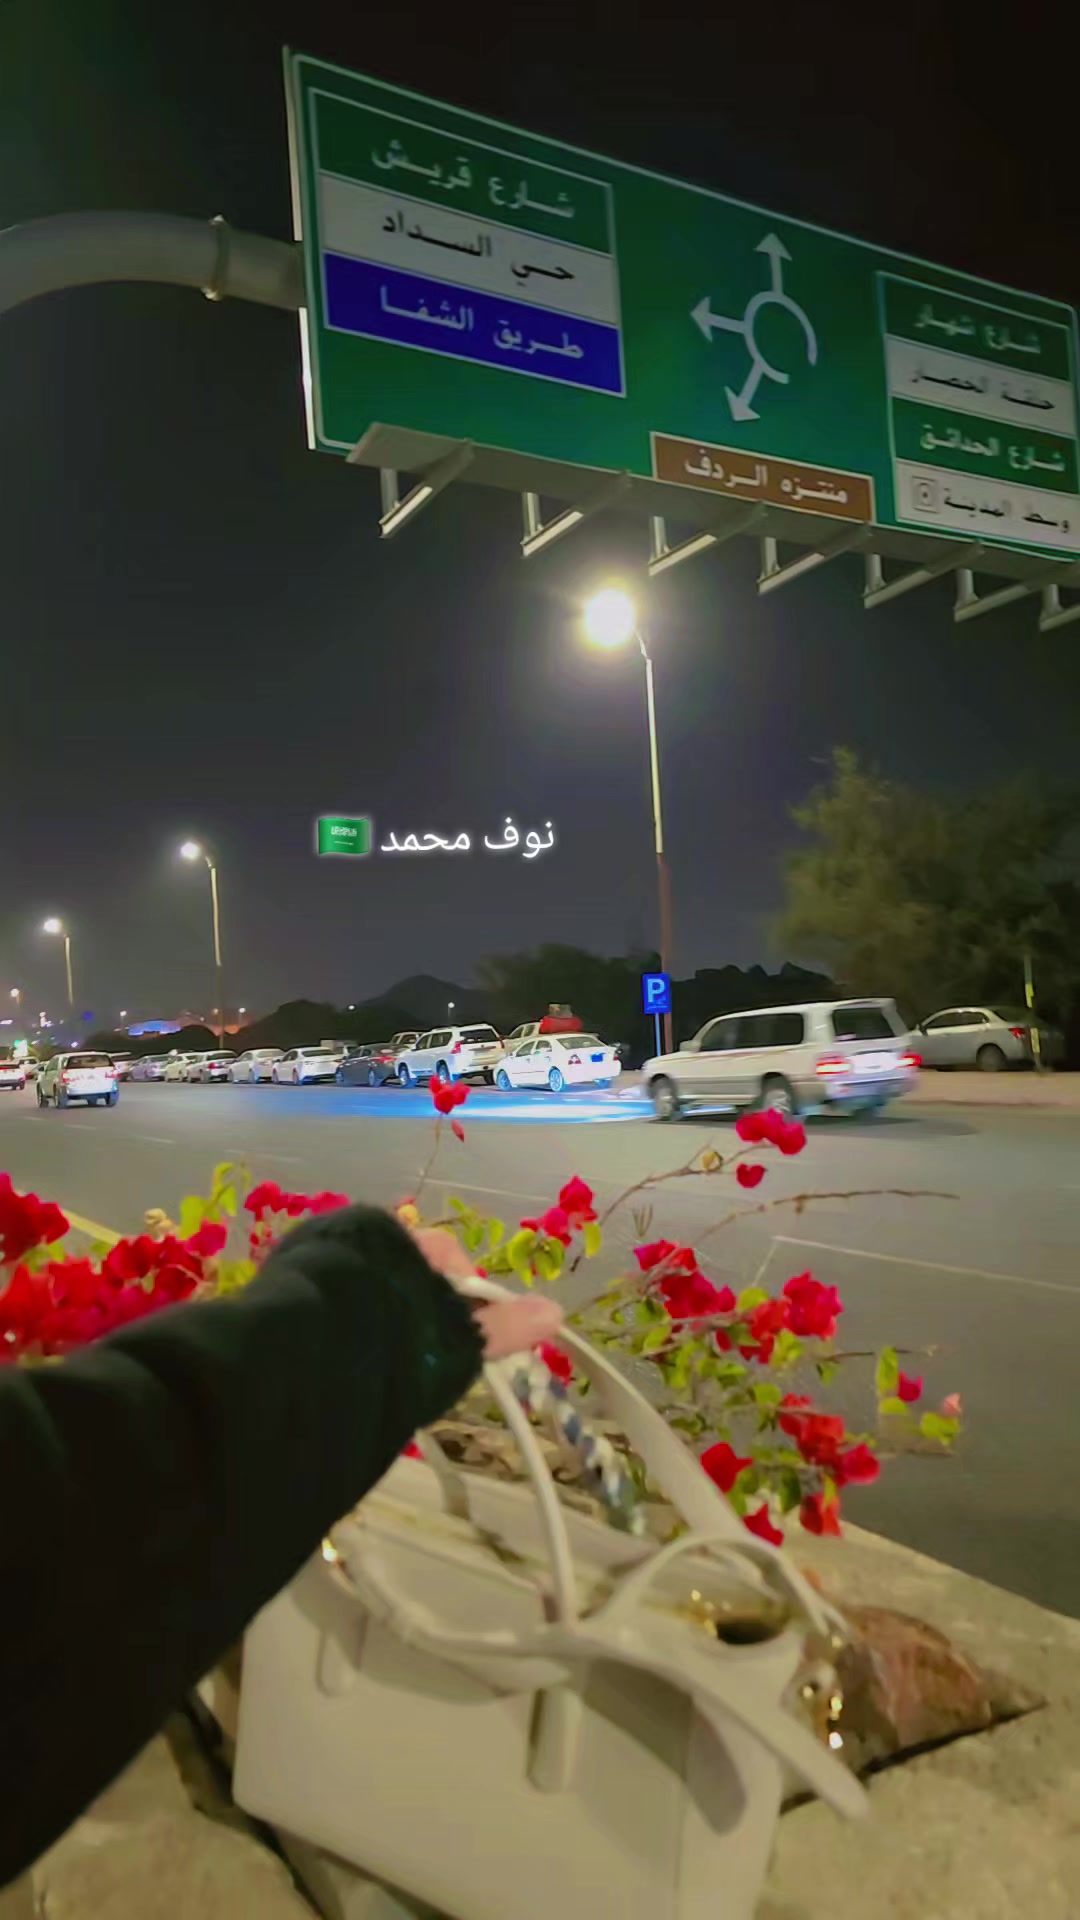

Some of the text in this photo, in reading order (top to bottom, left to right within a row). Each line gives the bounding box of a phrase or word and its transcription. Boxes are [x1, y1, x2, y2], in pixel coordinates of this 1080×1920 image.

[370, 138, 576, 219] شارع قريش
[381, 210, 576, 287] حي السداد
[380, 285, 585, 359] طريق الشفا
[983, 324, 1041, 354] شارع
[919, 424, 1066, 472] شارع الحدائق
[683, 448, 848, 504] منتزه الردف
[943, 487, 1070, 534] وسط المدينة
[647, 978, 665, 1003] P
